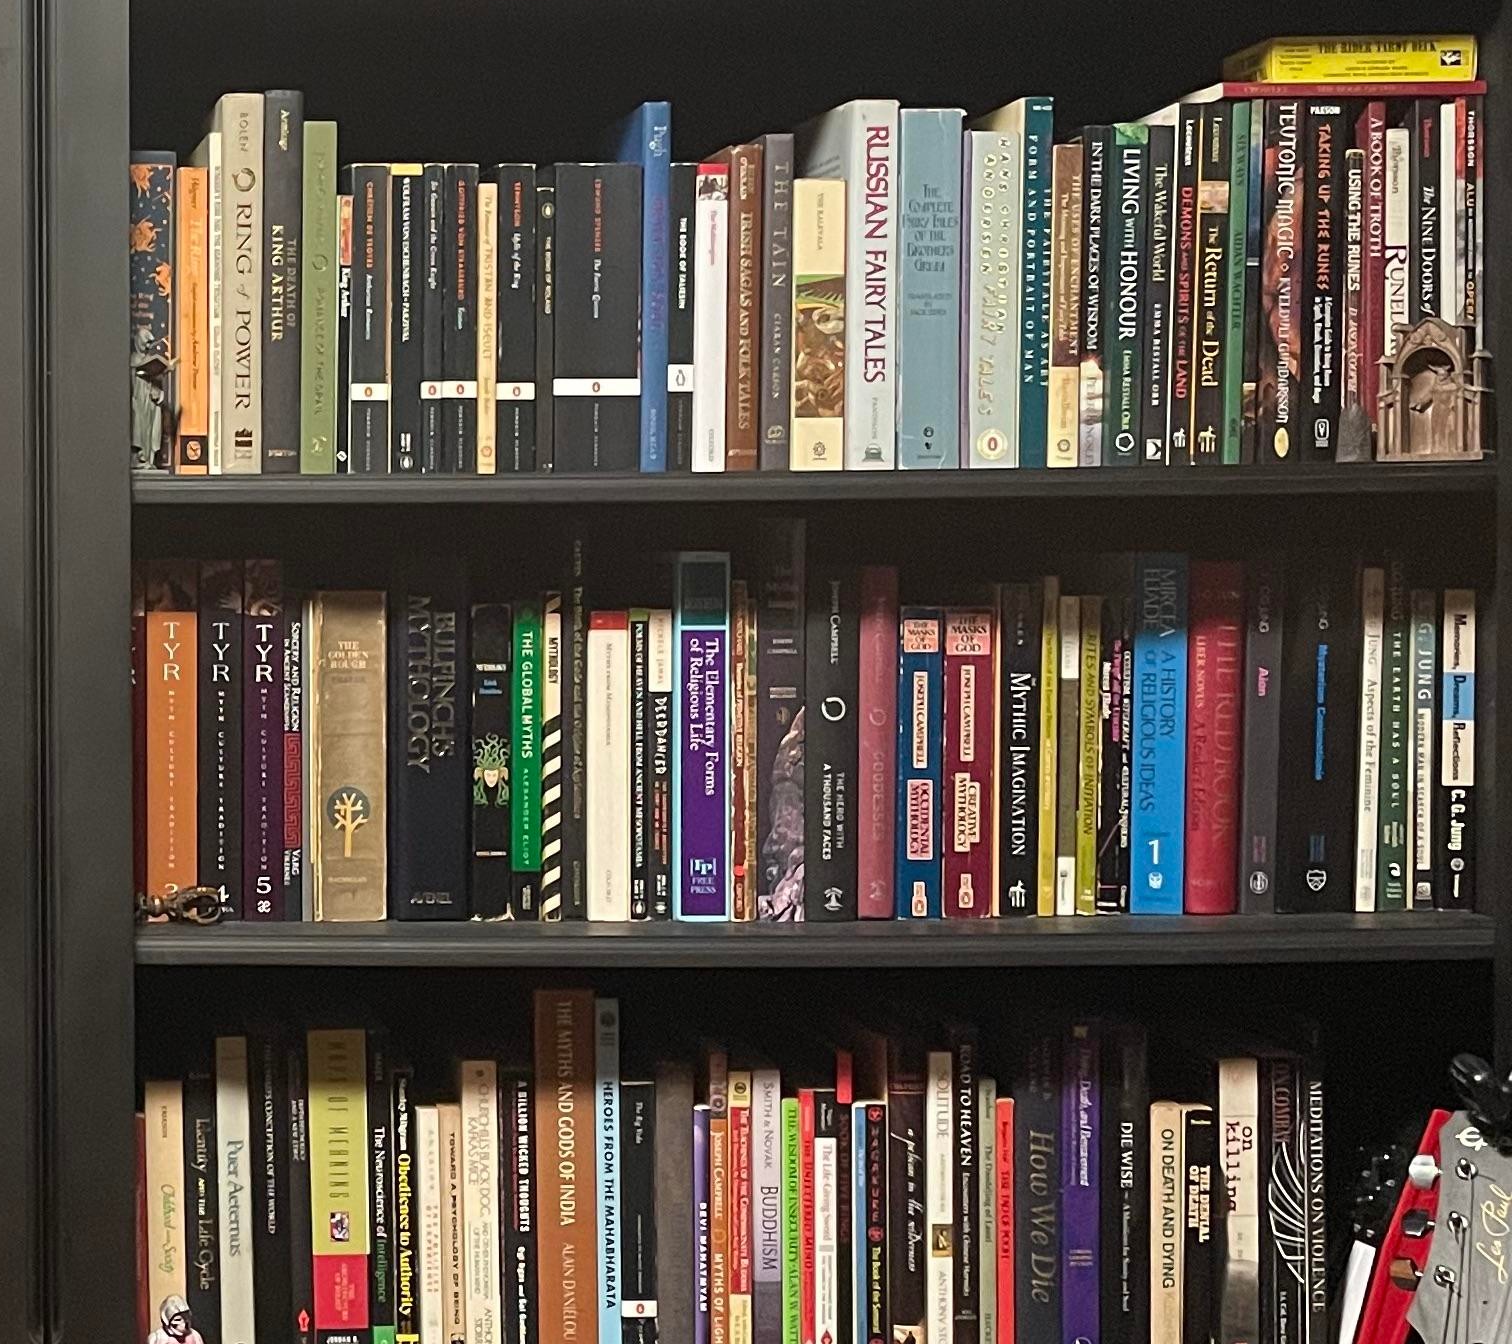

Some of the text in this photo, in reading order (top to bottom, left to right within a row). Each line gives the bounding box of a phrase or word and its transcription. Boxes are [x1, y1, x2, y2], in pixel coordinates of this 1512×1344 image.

[234, 203, 253, 410] RING POWER
[271, 225, 285, 341] KING ARTHUR
[864, 126, 889, 382] RUSSIAN FAIRY TALES
[1119, 148, 1142, 340] LIVING WITH HONOUR
[1348, 169, 1362, 291] USING THE RUNES
[521, 631, 534, 759] THE GLOBAL MYTHS
[687, 638, 704, 750] of Religious Life
[702, 638, 720, 795] The Elementary Forms
[1011, 673, 1031, 855] MYTHIC IMAGINATION
[1140, 650, 1158, 811] OF RELIGIOUS IDEAS
[1160, 651, 1176, 739] A HISTORY
[1448, 820, 1464, 850] Jung
[399, 1153, 413, 1315] Obedience to Authority
[603, 1082, 616, 1308] HEROES FROM THE MAHABHARATA
[761, 1186, 778, 1270] BUDDHISM
[1029, 1130, 1055, 1303] How We Die
[1161, 1129, 1175, 1288] ON DEATH AND DYING
